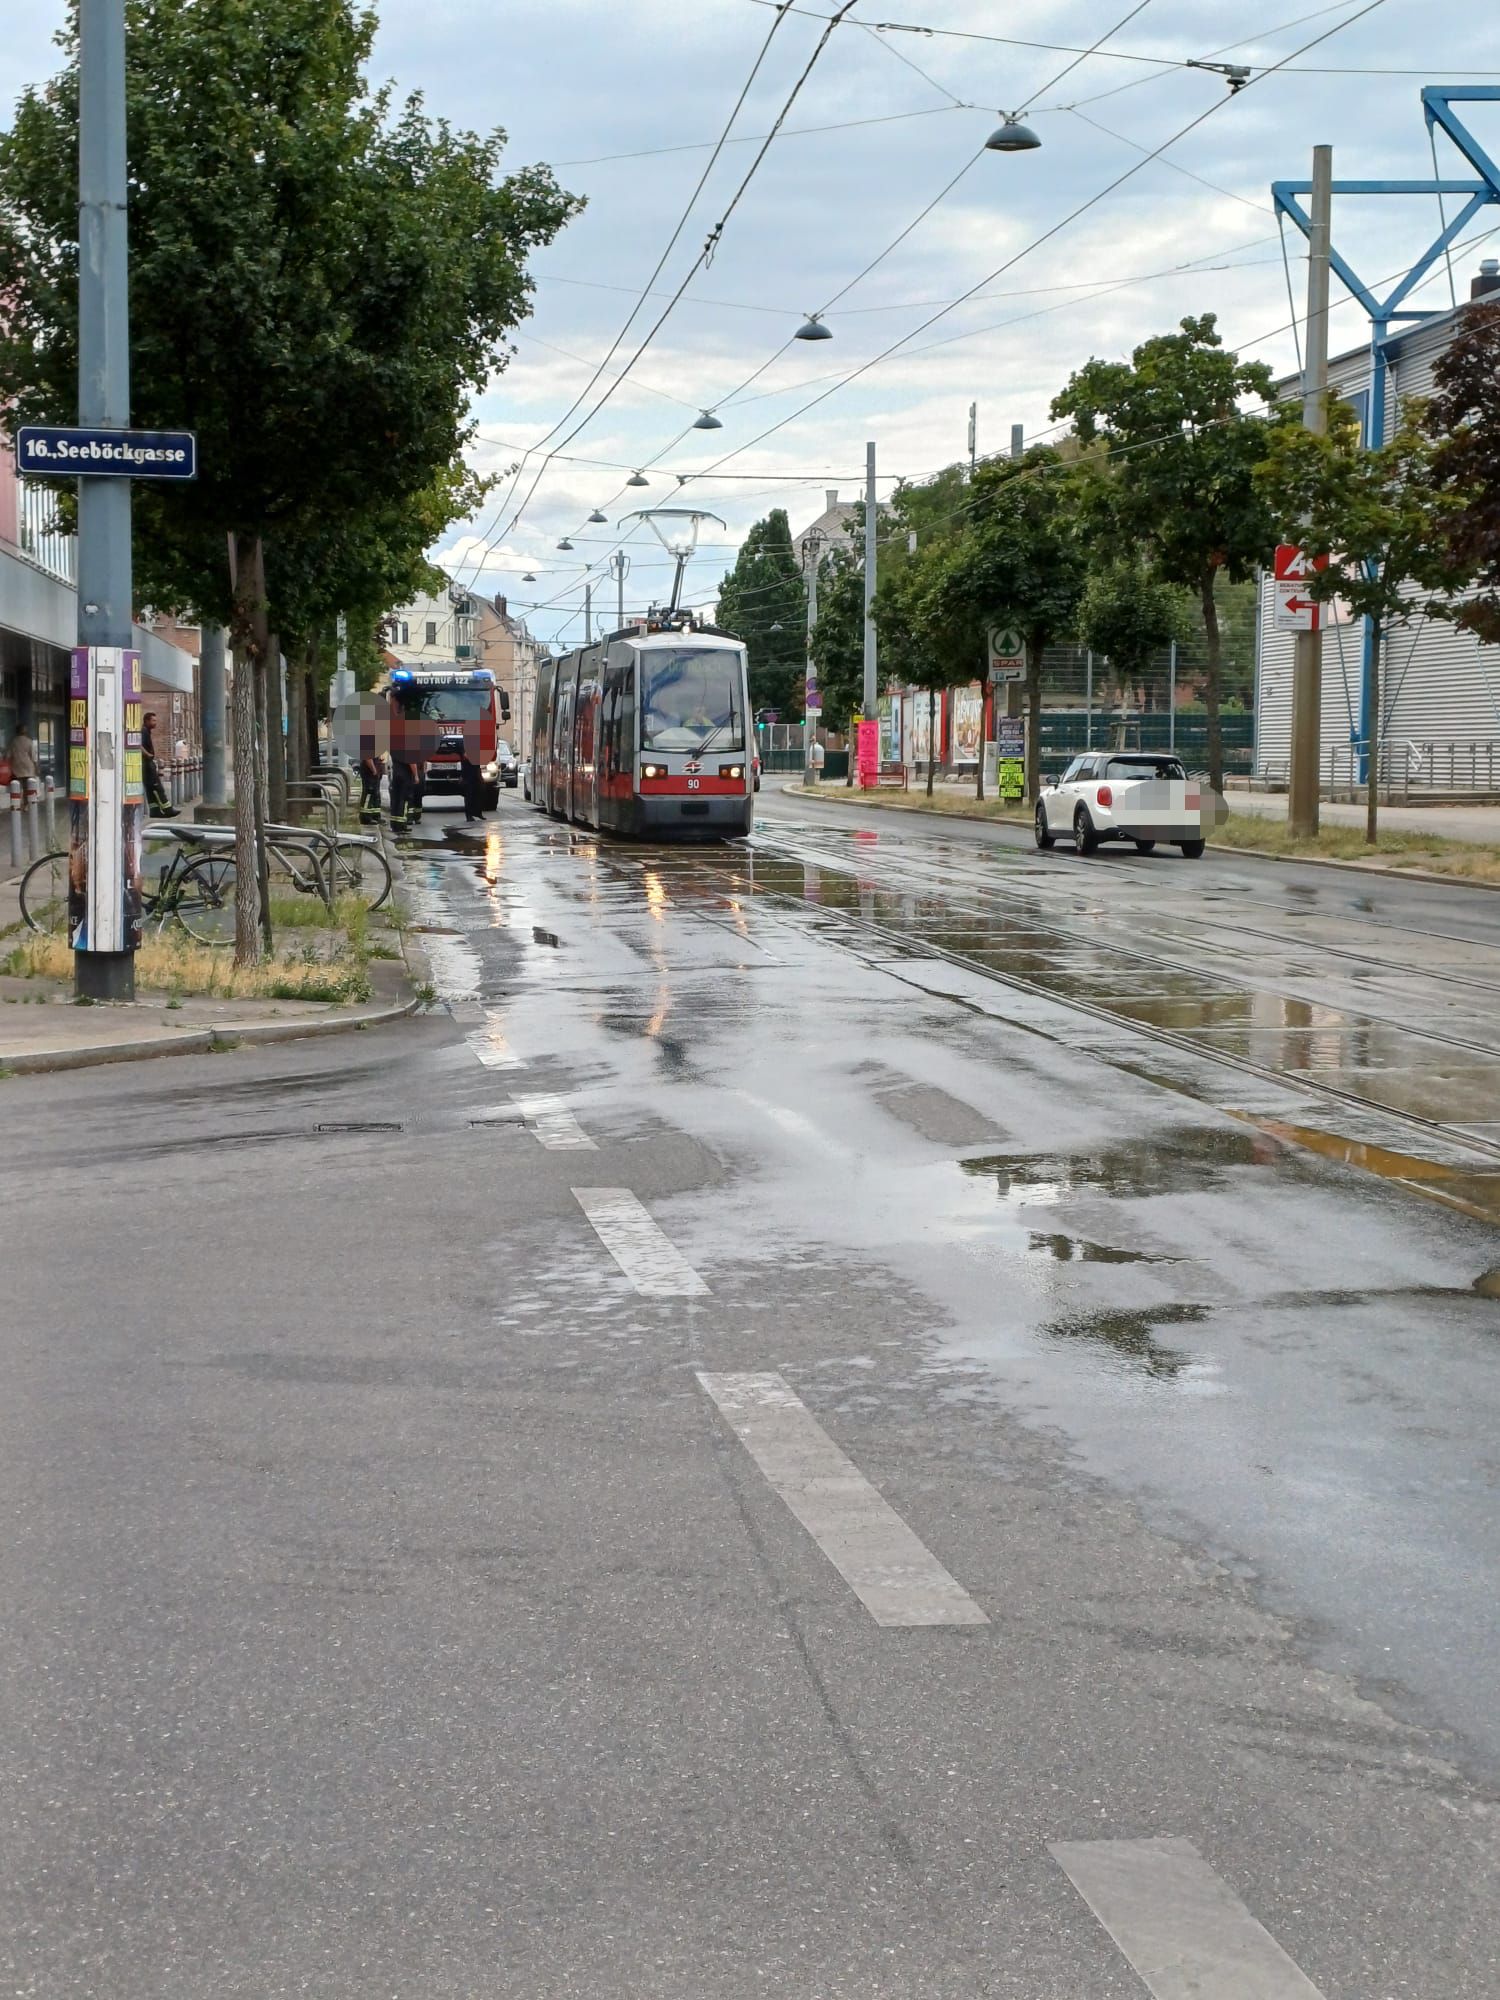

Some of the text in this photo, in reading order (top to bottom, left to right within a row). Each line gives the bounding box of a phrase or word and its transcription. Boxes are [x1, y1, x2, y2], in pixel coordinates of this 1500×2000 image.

[992, 659, 1023, 667] SPAR
[416, 676, 469, 685] NOTRUF 122
[687, 779, 700, 789] 90
